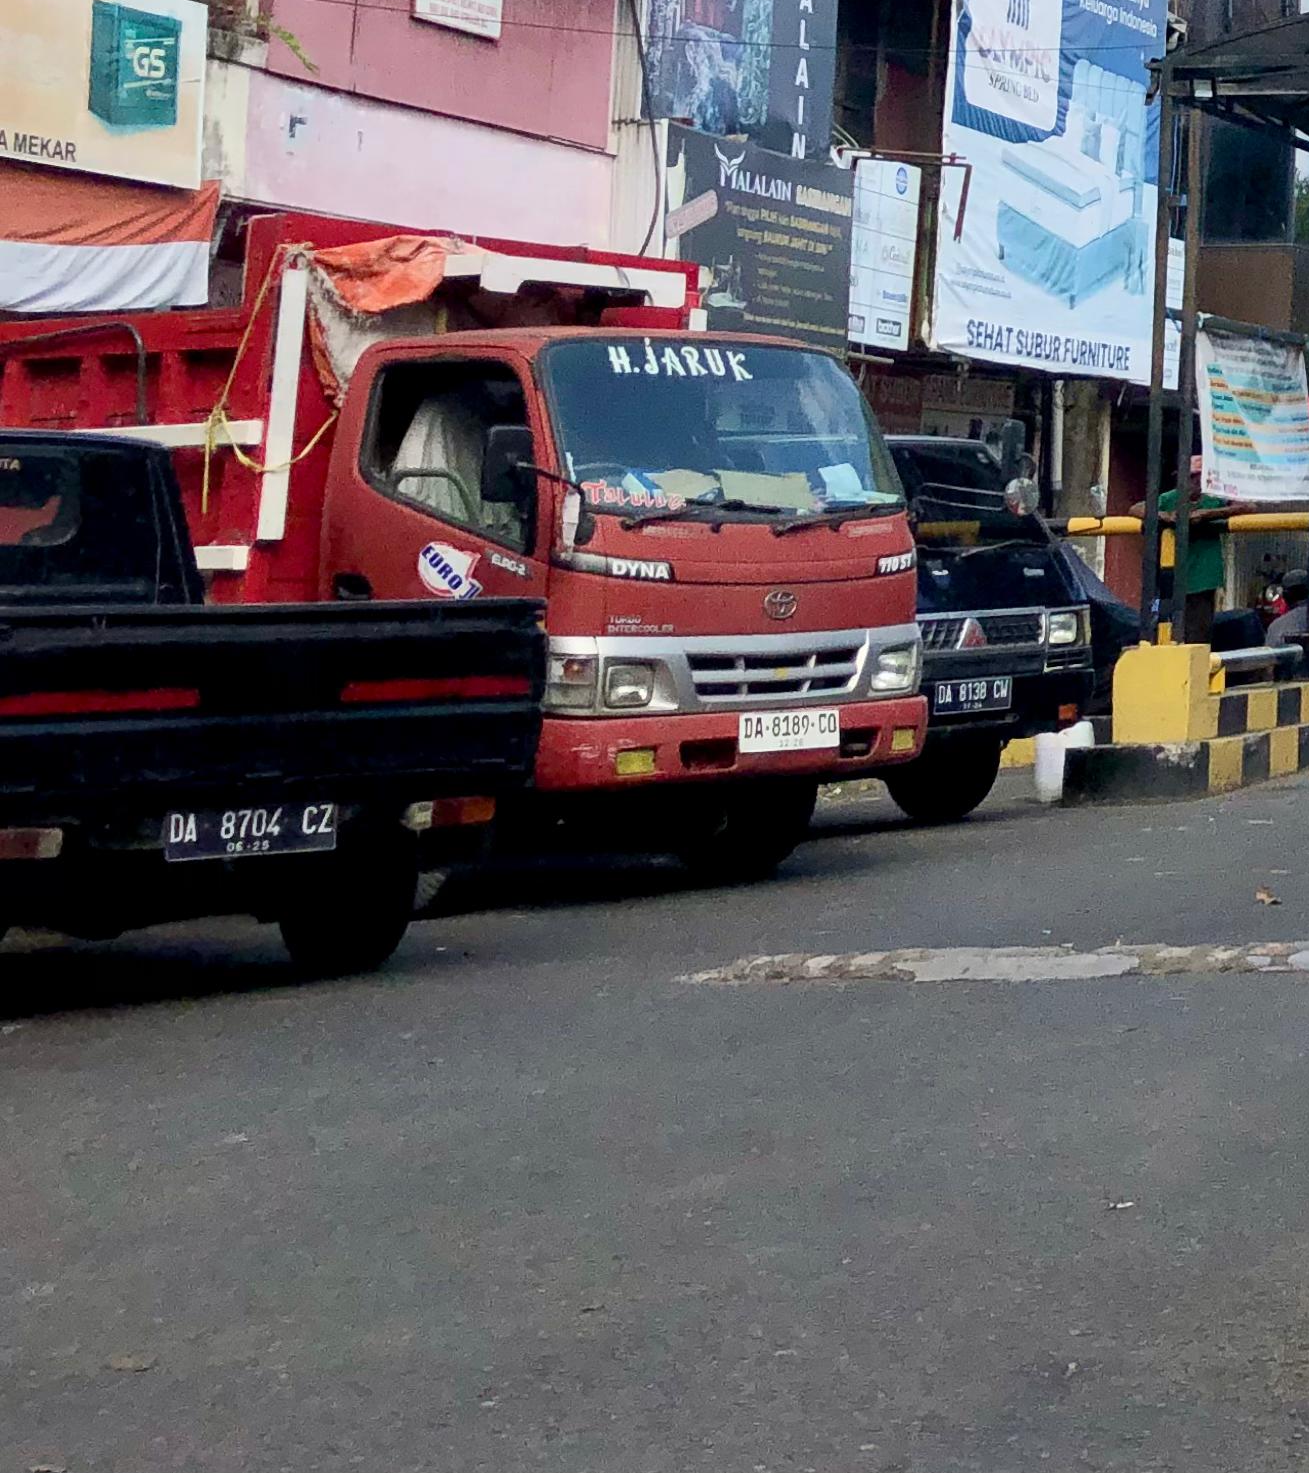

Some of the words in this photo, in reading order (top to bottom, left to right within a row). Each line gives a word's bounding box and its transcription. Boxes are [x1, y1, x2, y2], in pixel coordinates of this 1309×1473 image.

[1119, 6, 1158, 39] Indonesia
[133, 46, 166, 79] GS
[13, 132, 77, 163] MEKAR
[714, 143, 793, 203] MALALAIN
[966, 318, 1014, 353] SEHAT
[1016, 329, 1061, 362] SUBUR
[1063, 337, 1131, 371] FURNITURE
[0, 458, 21, 471] TA
[421, 545, 463, 590] EURO
[611, 561, 671, 579] DYNA
[608, 624, 674, 634] INTERCOOLER
[938, 686, 952, 705] DA
[744, 717, 763, 740] DA
[771, 714, 809, 737] 8189
[170, 812, 197, 844] DA
[219, 806, 283, 840] 8704
[301, 803, 334, 835] CZ
